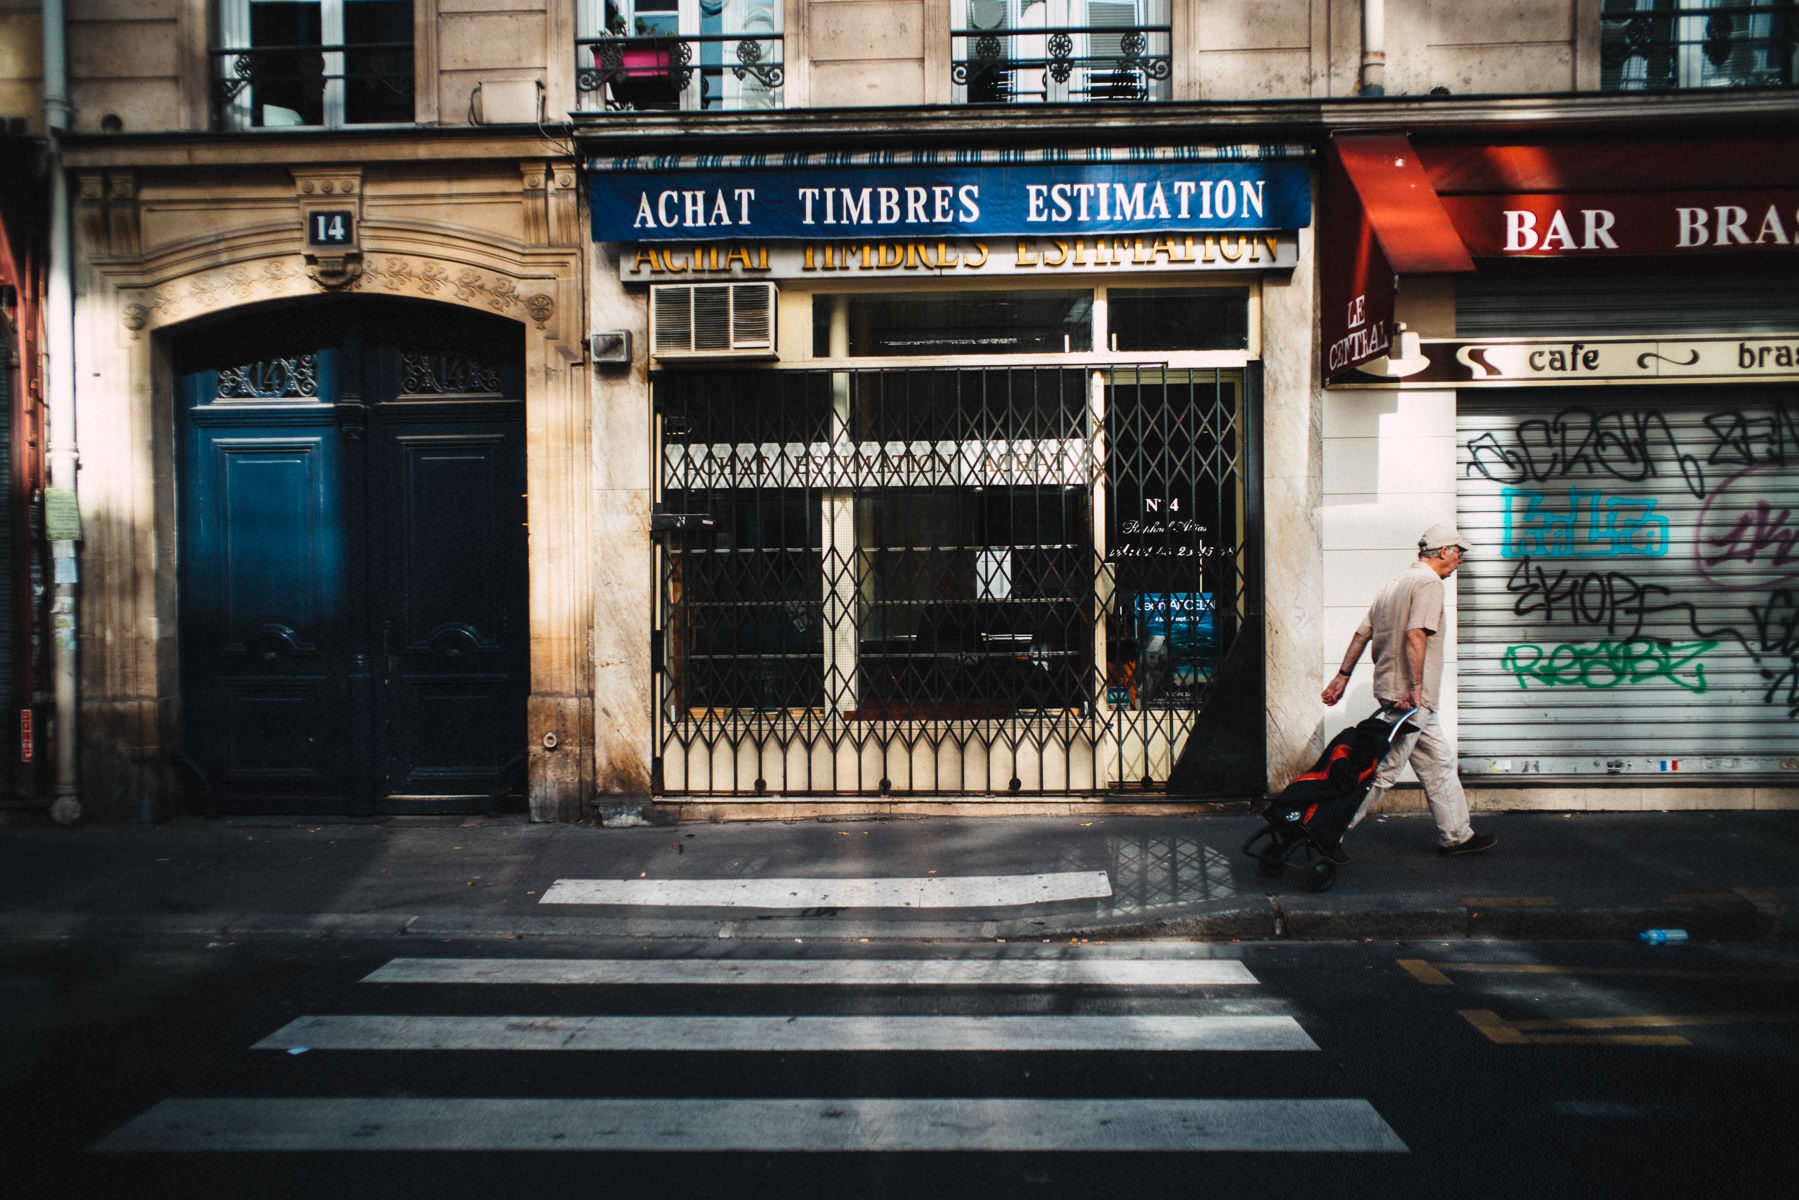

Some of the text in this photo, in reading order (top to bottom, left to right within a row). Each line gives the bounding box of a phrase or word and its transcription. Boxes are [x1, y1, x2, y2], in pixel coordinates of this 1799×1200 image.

[633, 180, 1265, 228] ACHAT TIMBRES ESTIMATION
[316, 215, 345, 241] 14
[1502, 203, 1799, 251] BAR BRA
[1347, 294, 1366, 329] LE
[1329, 320, 1389, 371] CENTRAL
[1528, 342, 1799, 371] cafe bra
[1169, 497, 1180, 512] 4
